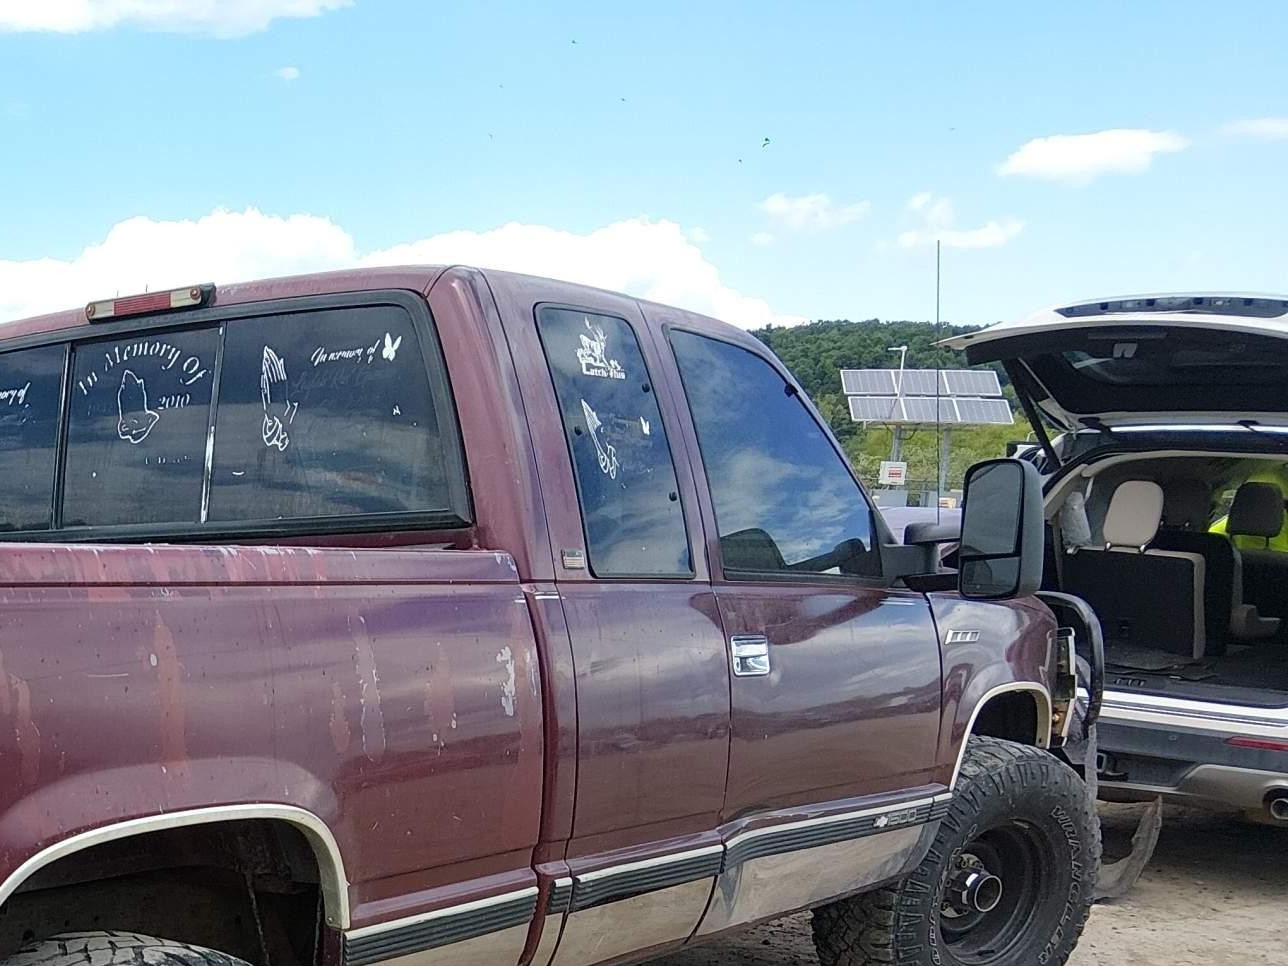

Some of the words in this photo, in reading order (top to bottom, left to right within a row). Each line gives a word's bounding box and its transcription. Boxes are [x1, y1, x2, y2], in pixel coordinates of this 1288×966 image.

[77, 371, 98, 396] In
[104, 341, 181, 371] Memory
[1038, 804, 1083, 966] WRANGLER
